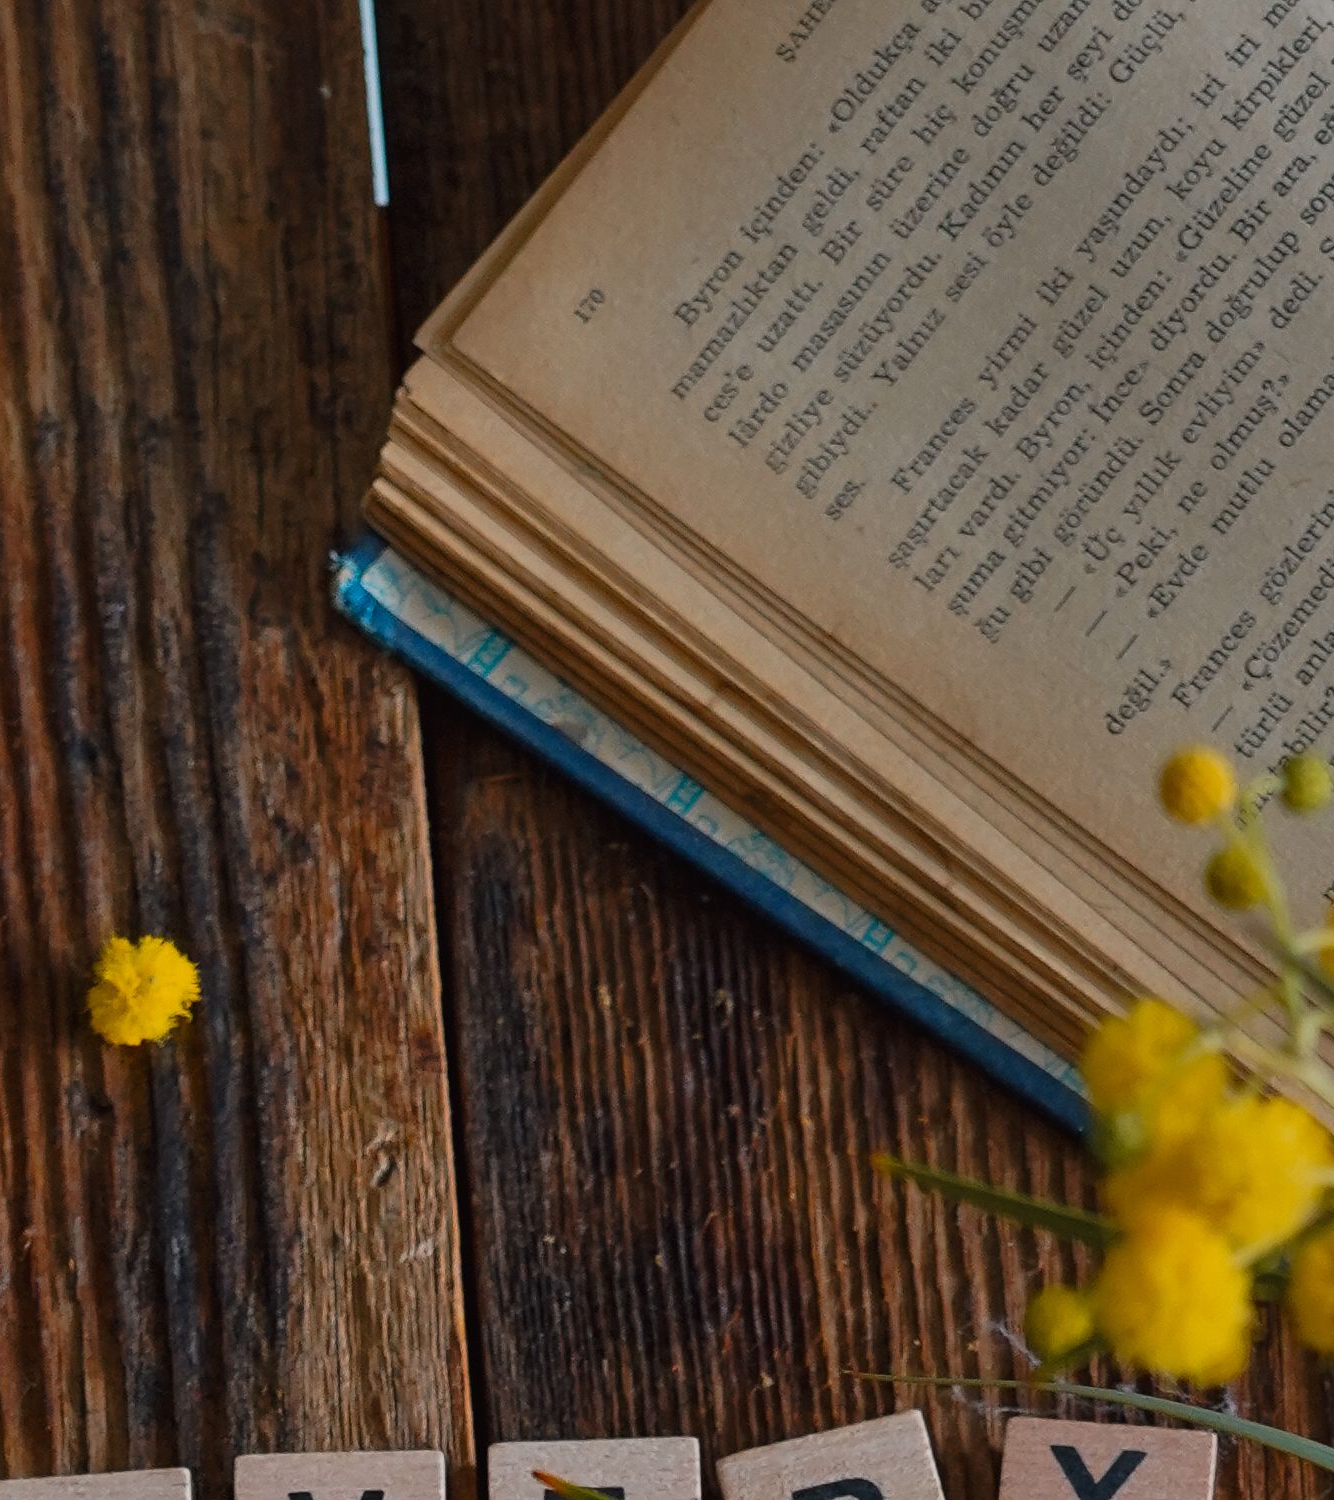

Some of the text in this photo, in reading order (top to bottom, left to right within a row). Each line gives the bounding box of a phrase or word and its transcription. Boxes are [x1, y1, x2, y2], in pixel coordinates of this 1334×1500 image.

[573, 288, 606, 324] 170
[889, 116, 1196, 496] Frances yirmi iki yaşındaydı;
[981, 361, 1050, 439] kadar
[1051, 283, 1110, 360] güzel
[1108, 216, 1173, 279] uzun,
[1163, 137, 1229, 203] koyu
[1114, 373, 1290, 599] «Peki, ne olmuş?»
[1146, 543, 1210, 619] «Evde
[1209, 457, 1277, 536] mutlu
[1169, 610, 1257, 712] Frances
